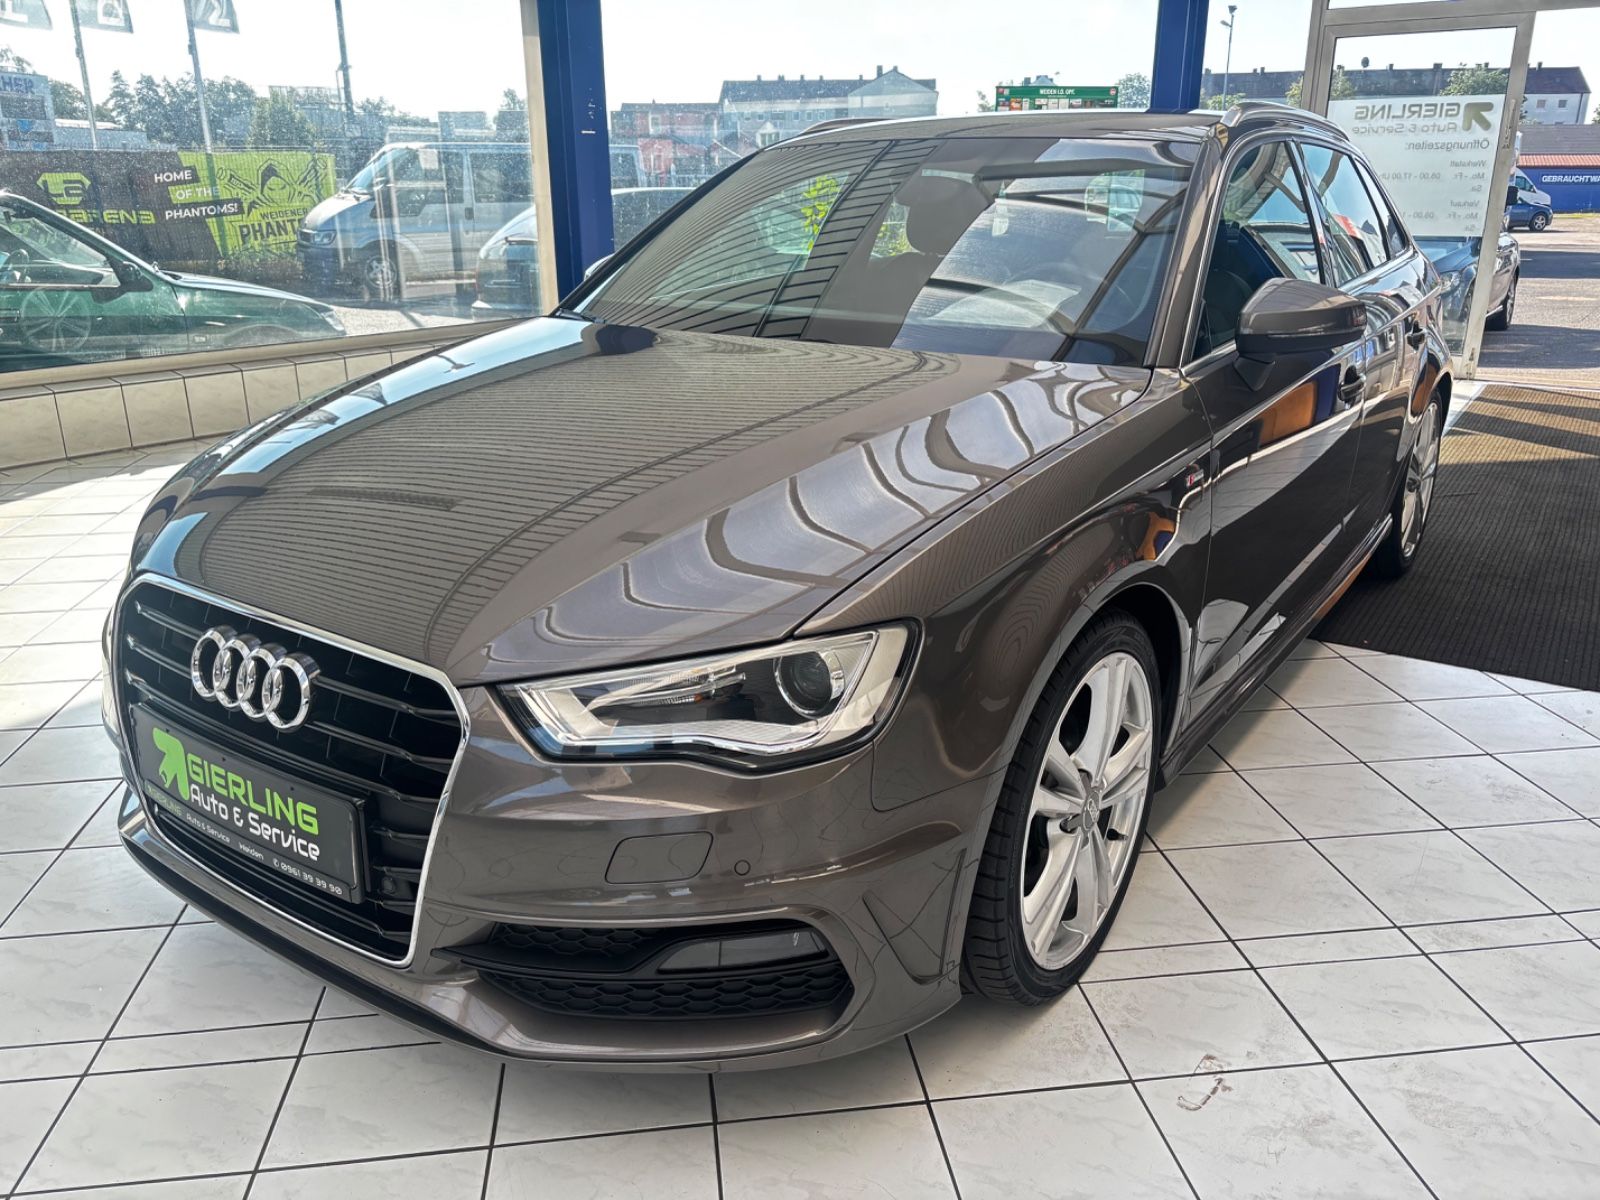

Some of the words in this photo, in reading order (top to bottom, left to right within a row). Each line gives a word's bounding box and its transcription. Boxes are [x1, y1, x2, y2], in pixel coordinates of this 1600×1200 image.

[154, 170, 192, 183] HOME
[176, 188, 192, 200] OF
[195, 186, 219, 198] THE
[165, 203, 239, 221] PHANTOMS!
[239, 219, 300, 245] PHANT
[187, 753, 319, 835] GIERLING
[190, 783, 229, 820] Auto
[233, 806, 244, 827] &
[248, 811, 320, 861] Service
[207, 824, 231, 843] Service
